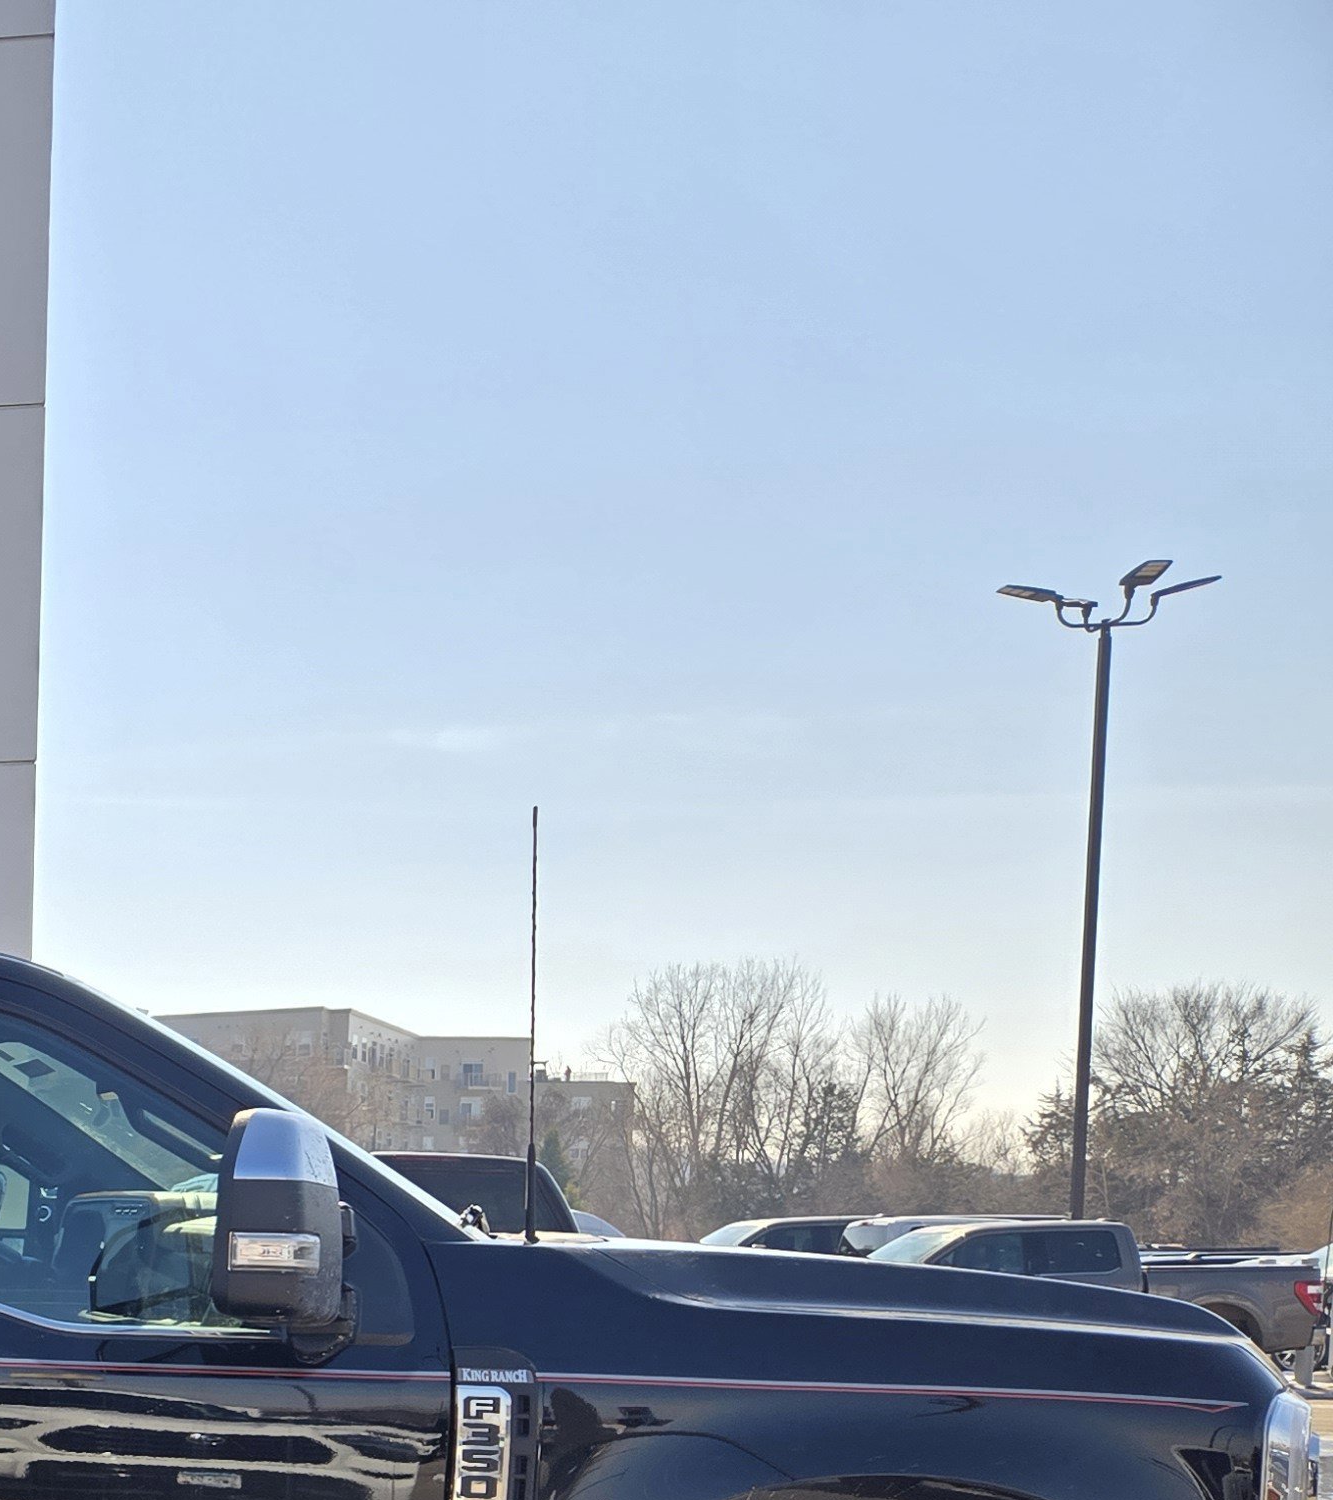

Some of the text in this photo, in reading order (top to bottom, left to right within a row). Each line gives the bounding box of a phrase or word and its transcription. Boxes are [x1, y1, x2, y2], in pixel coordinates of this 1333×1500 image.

[462, 1368, 528, 1383] KING RANCH
[460, 1396, 502, 1499] F350
